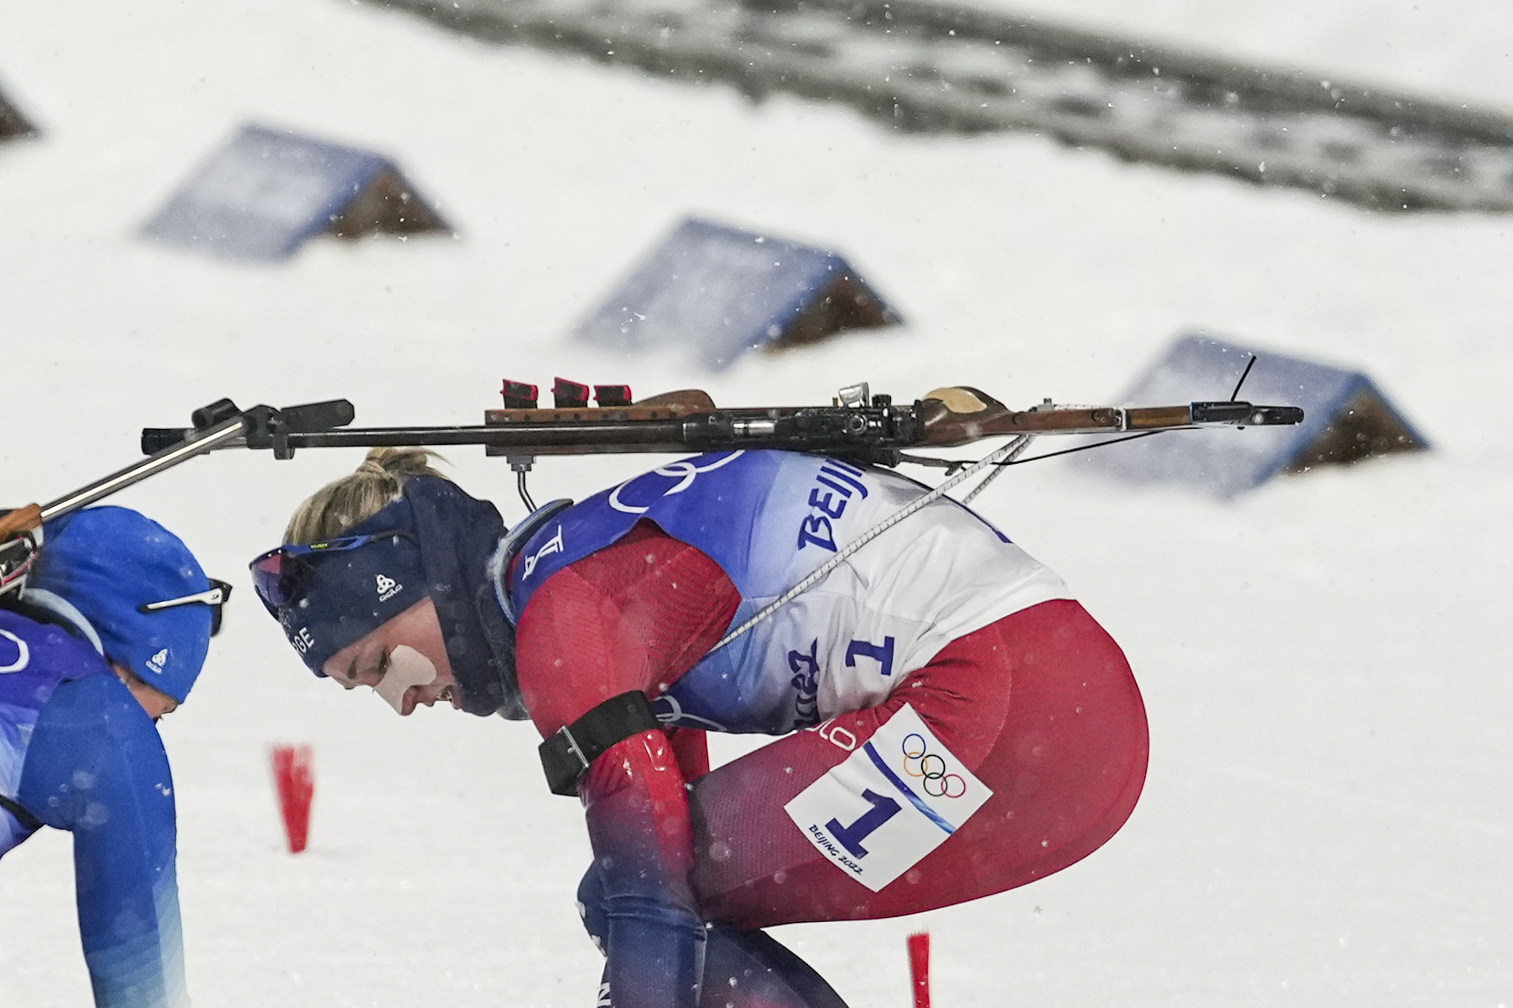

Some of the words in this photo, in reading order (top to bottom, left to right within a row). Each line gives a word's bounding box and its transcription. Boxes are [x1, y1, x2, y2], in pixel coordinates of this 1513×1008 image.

[797, 457, 869, 553] BEIJI
[788, 636, 821, 729] 022
[845, 635, 895, 677] 1
[808, 823, 840, 857] BEIJING
[837, 854, 864, 875] 2022
[824, 788, 903, 860] 1
